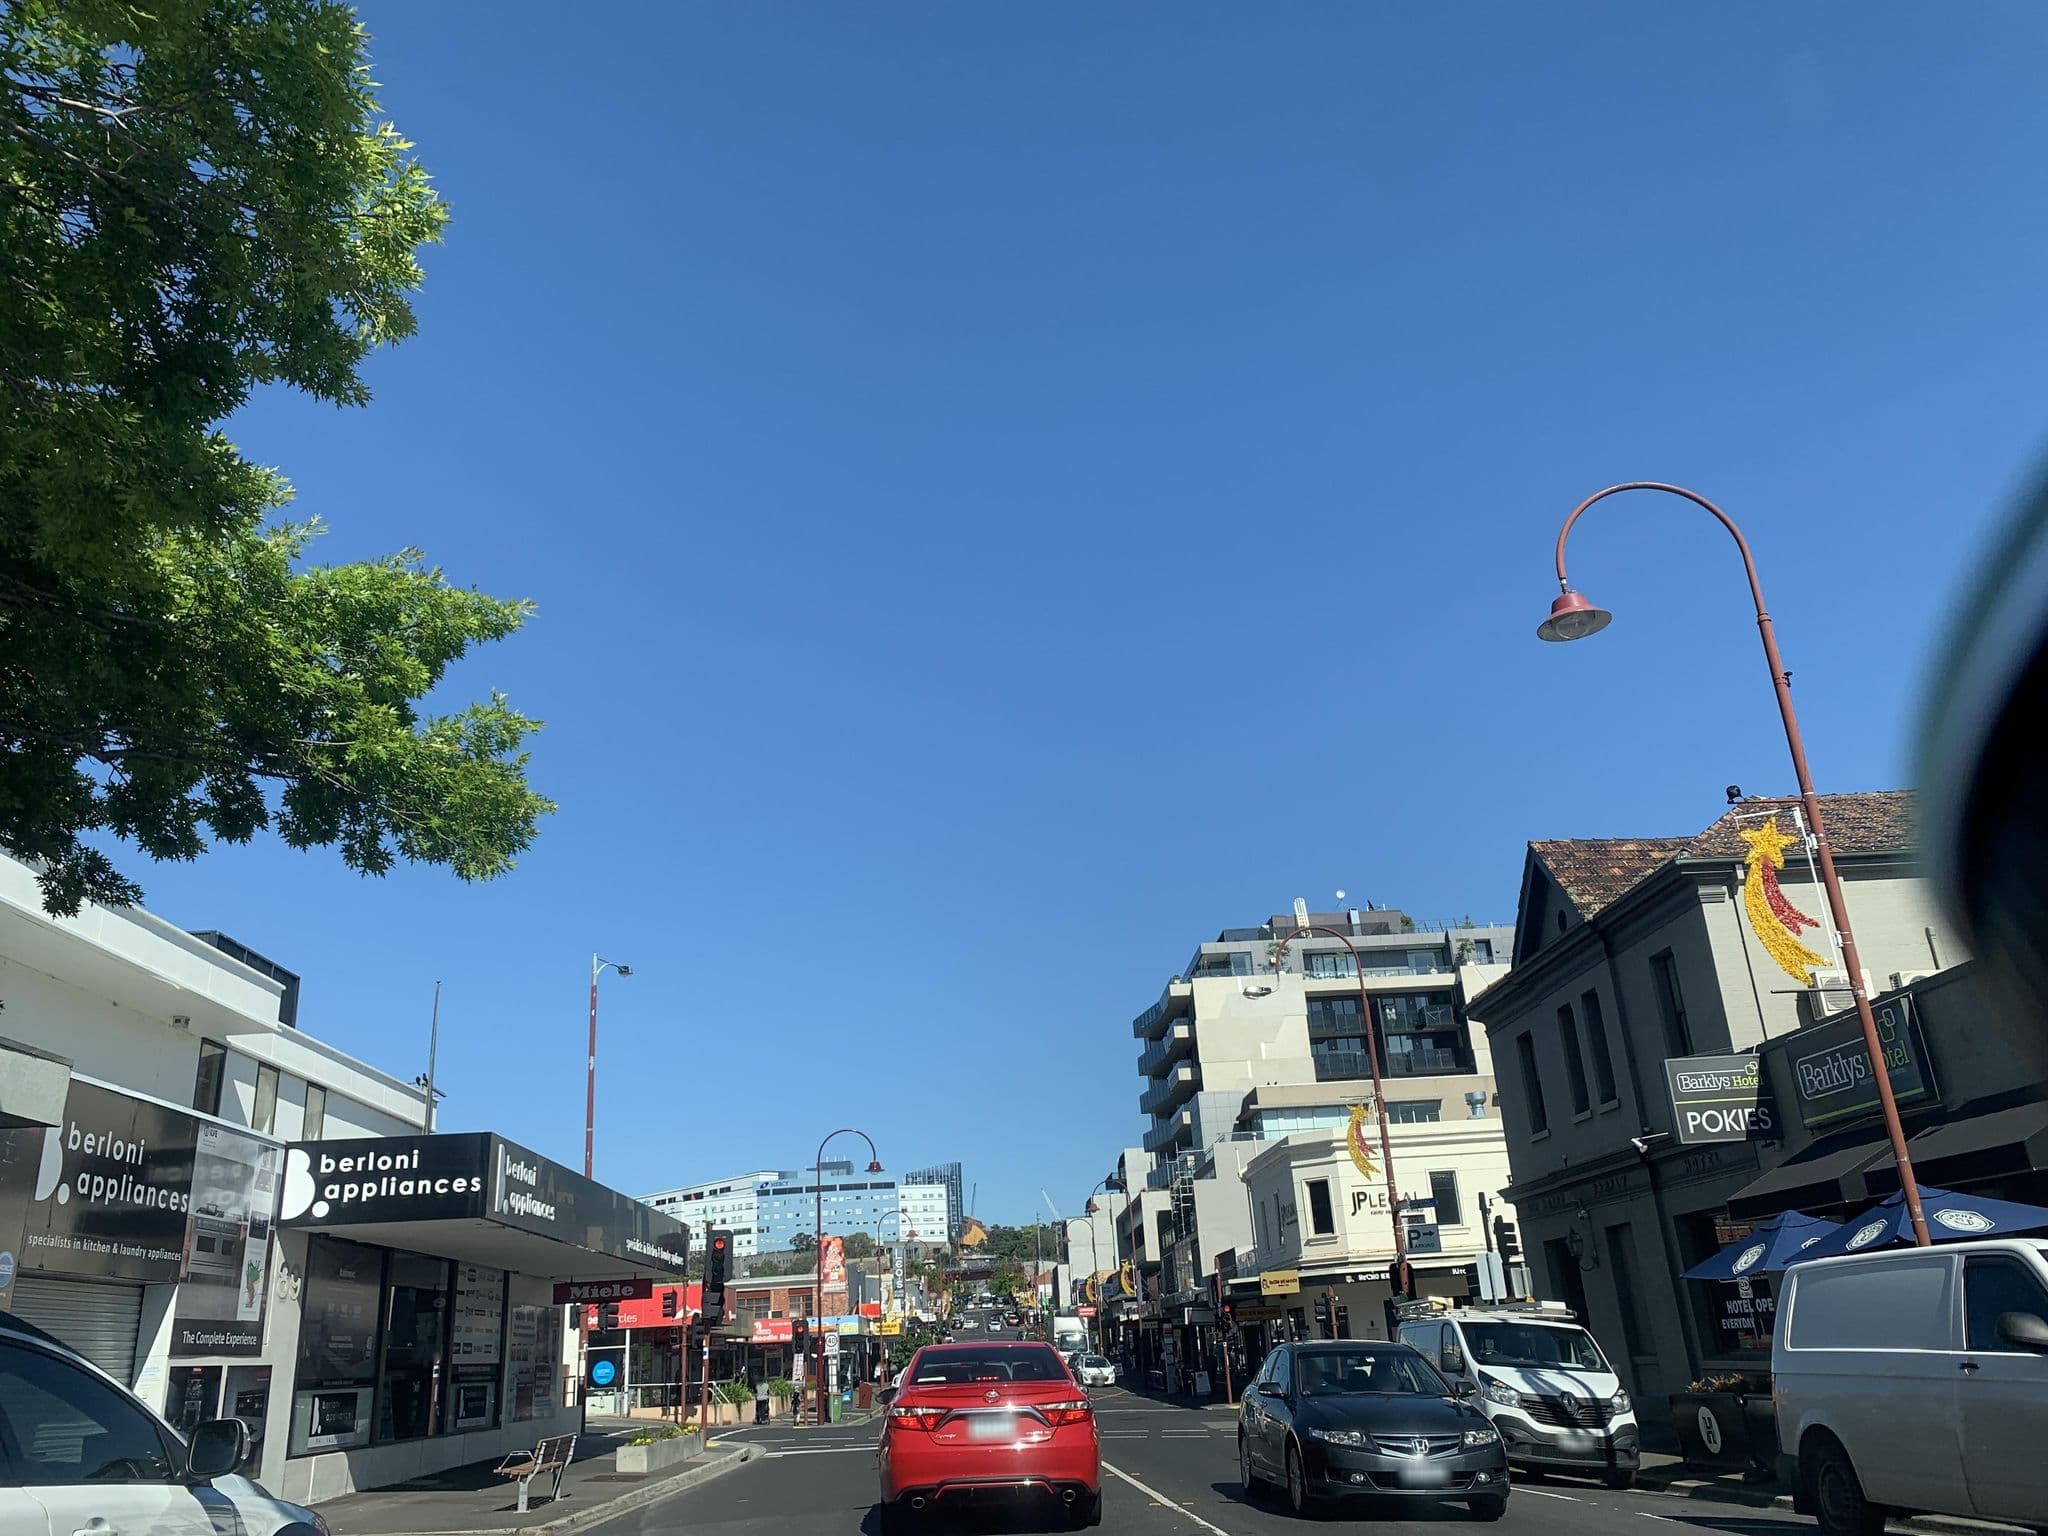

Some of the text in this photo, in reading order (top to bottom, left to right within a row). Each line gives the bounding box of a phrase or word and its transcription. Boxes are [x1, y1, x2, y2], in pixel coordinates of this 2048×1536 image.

[1680, 1074, 1763, 1090] Barklys Hotel
[1801, 1053, 1866, 1094] Barklys
[1686, 1107, 1772, 1134] POKIES
[68, 1121, 145, 1165] berloni
[320, 1149, 419, 1173] berloni
[505, 1154, 537, 1186] berloni
[77, 1172, 188, 1213] appliances
[324, 1176, 481, 1203] appliances
[510, 1191, 555, 1221] appliances
[28, 1234, 182, 1261] specialists in kitchen & laundry appliances
[570, 1284, 634, 1299] Miele
[619, 1312, 638, 1323] cles
[1726, 1297, 1775, 1314] HOTEL OPE
[1722, 1317, 1756, 1329] EVERYDAY
[183, 1331, 257, 1347] The Complete Experience
[827, 1336, 837, 1345] 40
